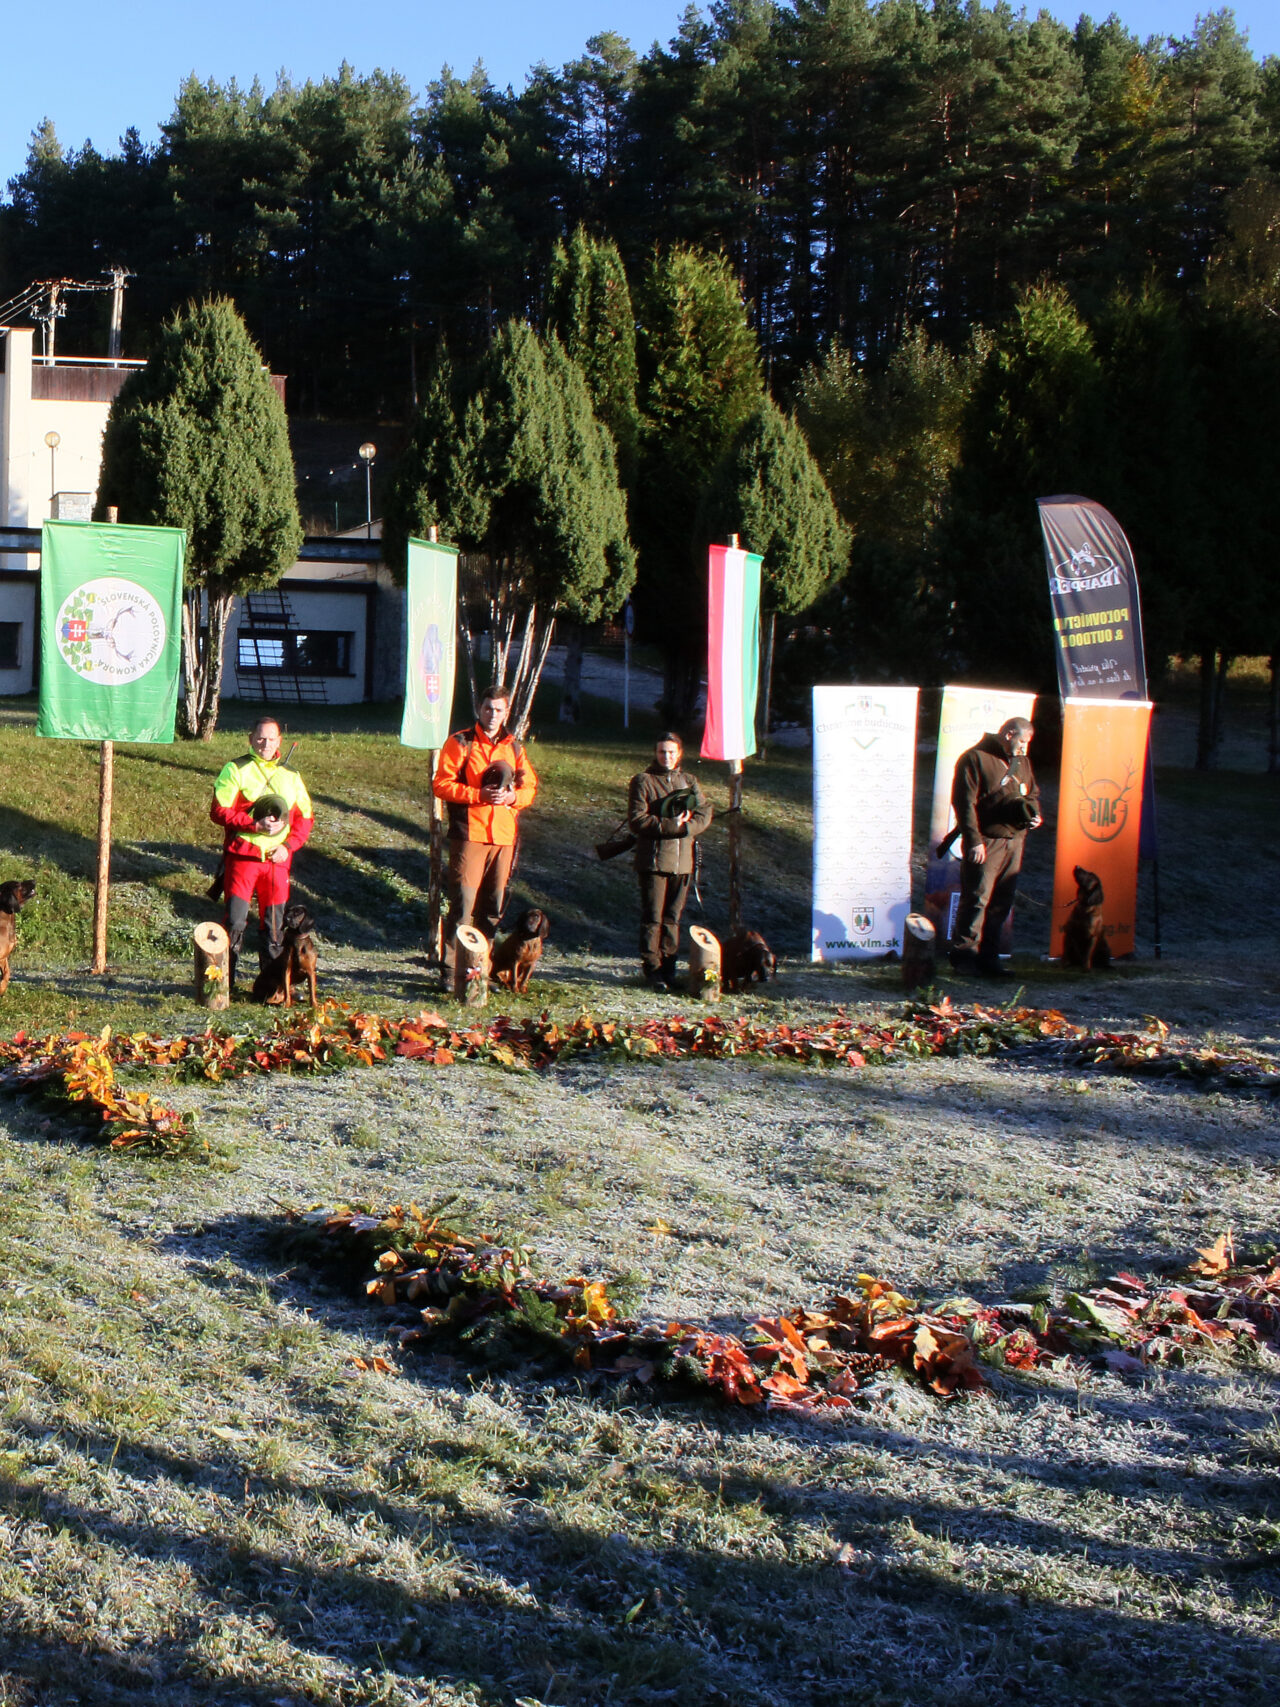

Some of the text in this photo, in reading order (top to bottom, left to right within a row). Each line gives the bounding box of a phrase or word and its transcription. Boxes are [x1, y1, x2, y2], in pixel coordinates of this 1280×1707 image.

[96, 592, 160, 675] SLOVENSKÁ POĽOVNÍCKA KOMORA
[465, 931, 478, 944] 3
[697, 932, 713, 944] 2
[825, 938, 900, 949] www.vlm.sk
